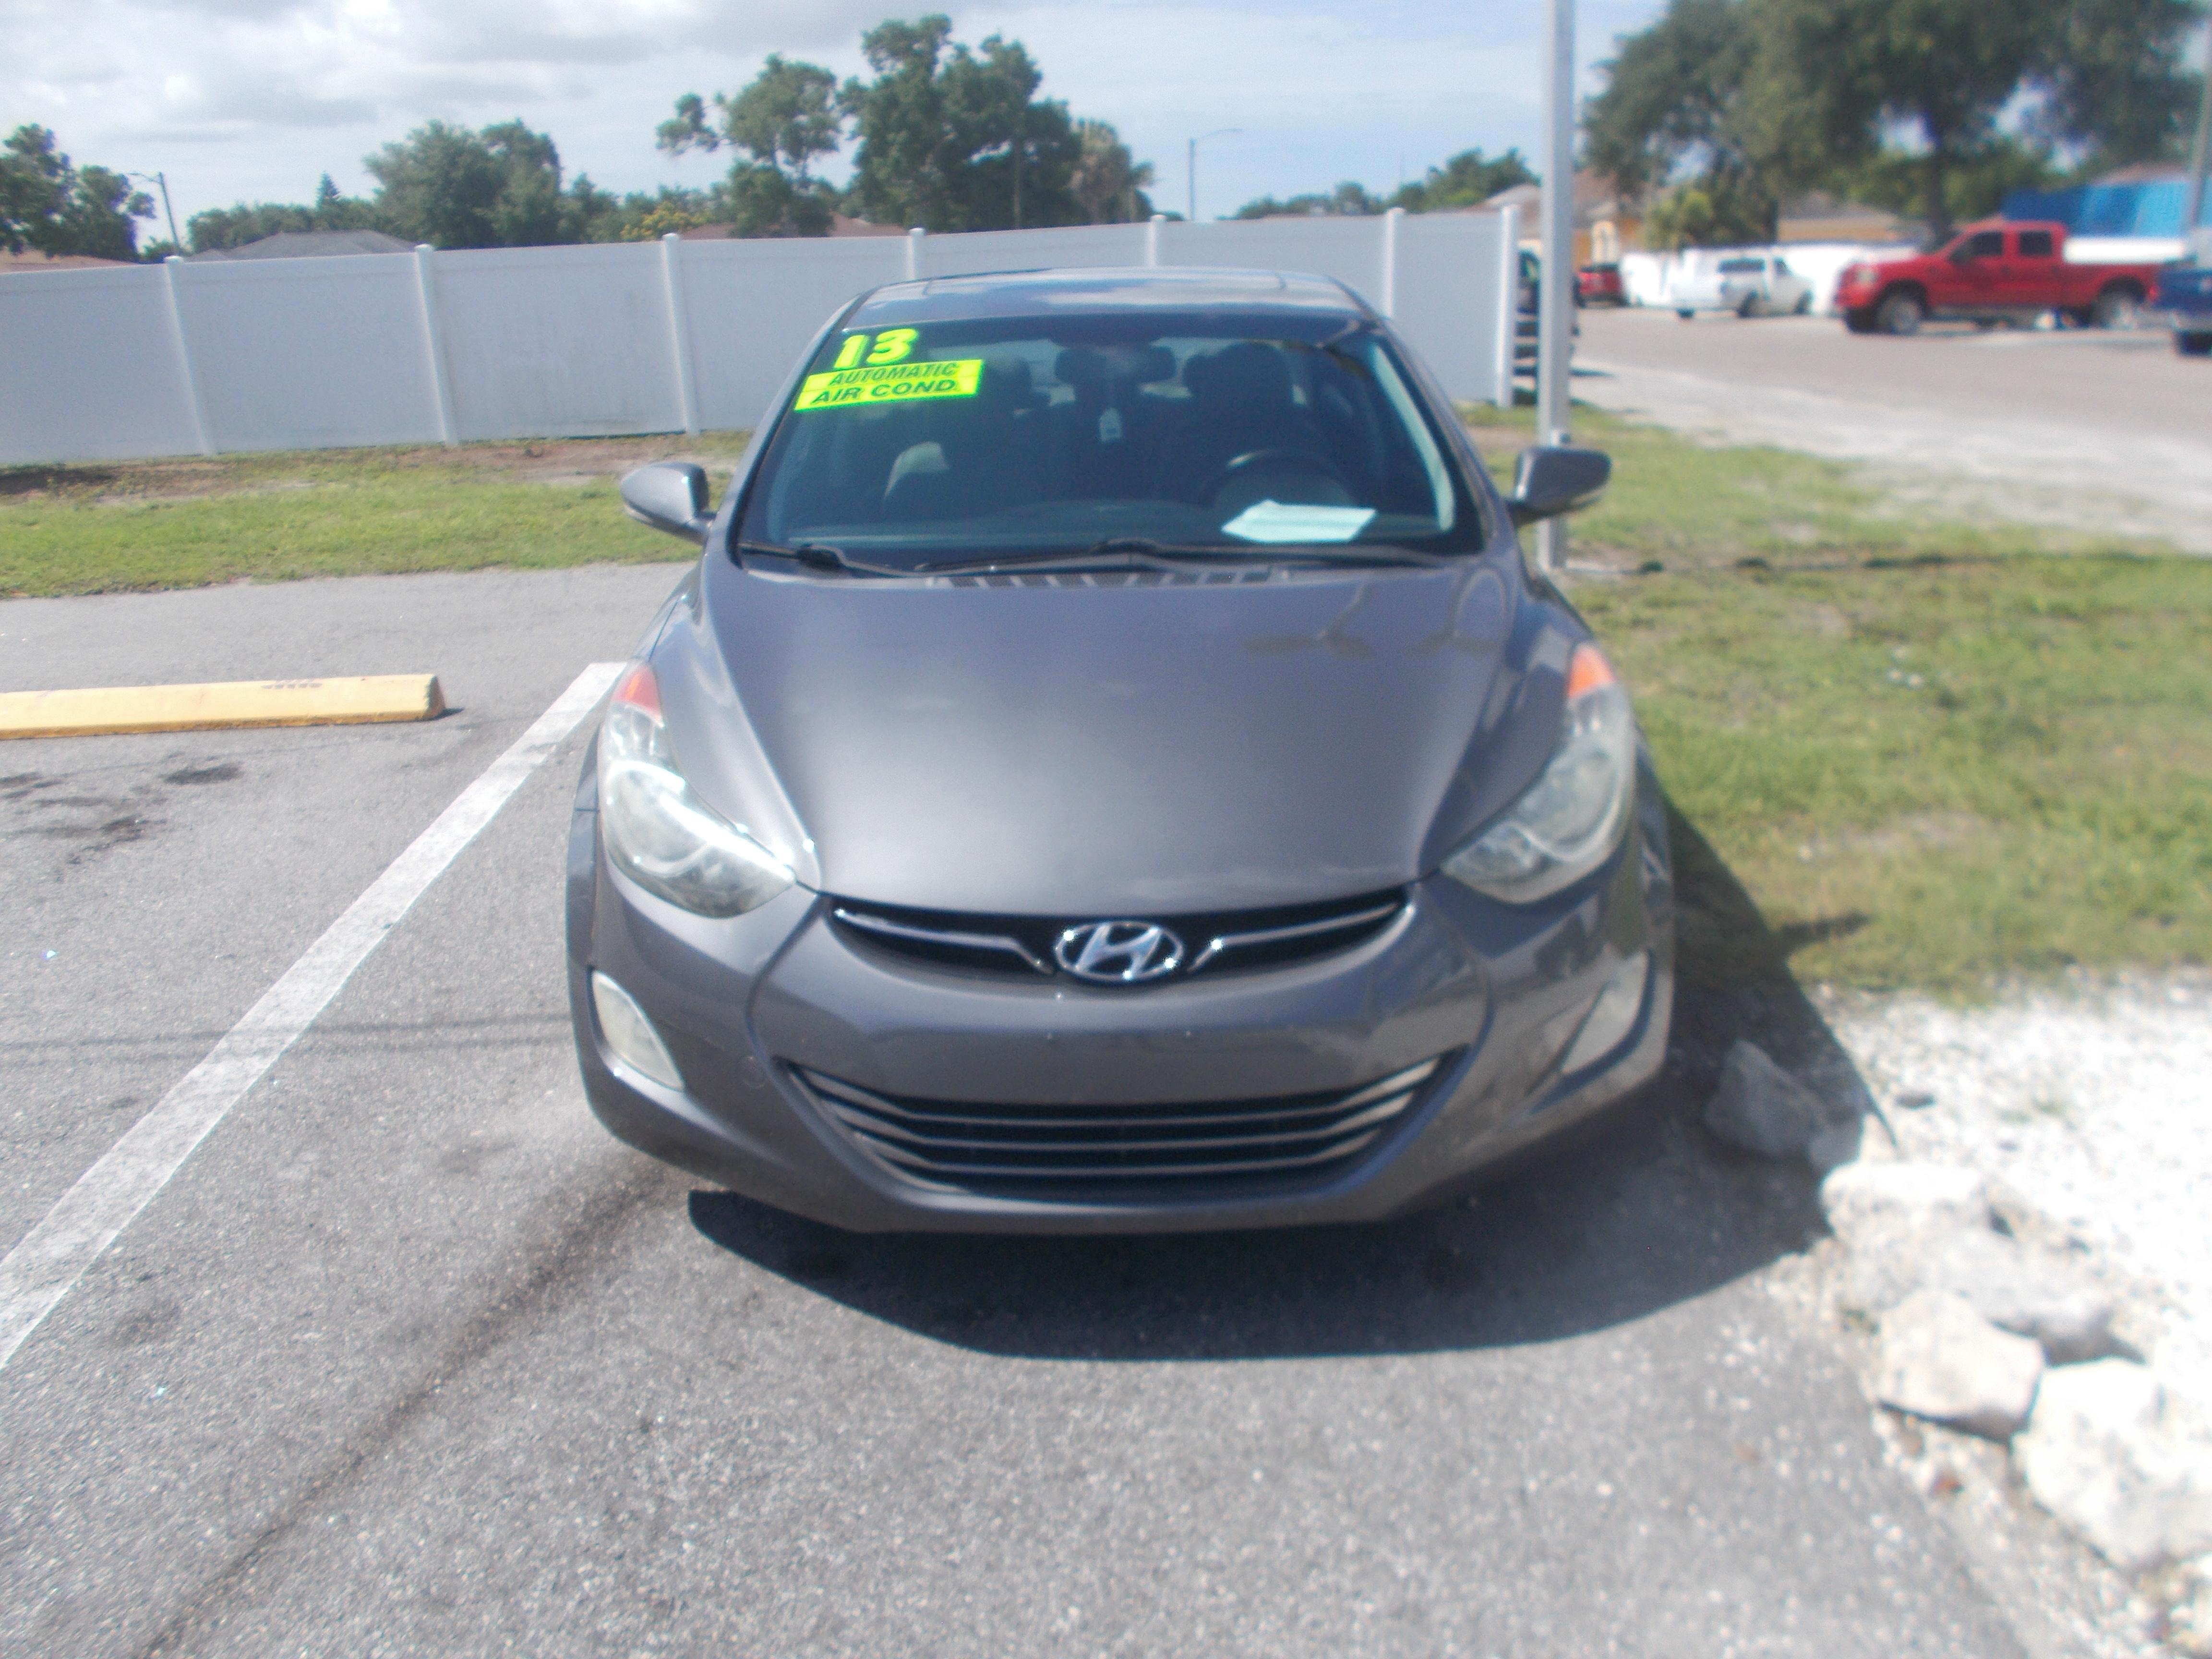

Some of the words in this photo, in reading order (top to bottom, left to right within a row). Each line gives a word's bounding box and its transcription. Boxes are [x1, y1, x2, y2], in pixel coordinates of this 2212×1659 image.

[834, 328, 918, 369] 13
[830, 362, 958, 386] AUTOMATIC
[811, 387, 863, 404] AIR
[871, 380, 956, 397] COND
